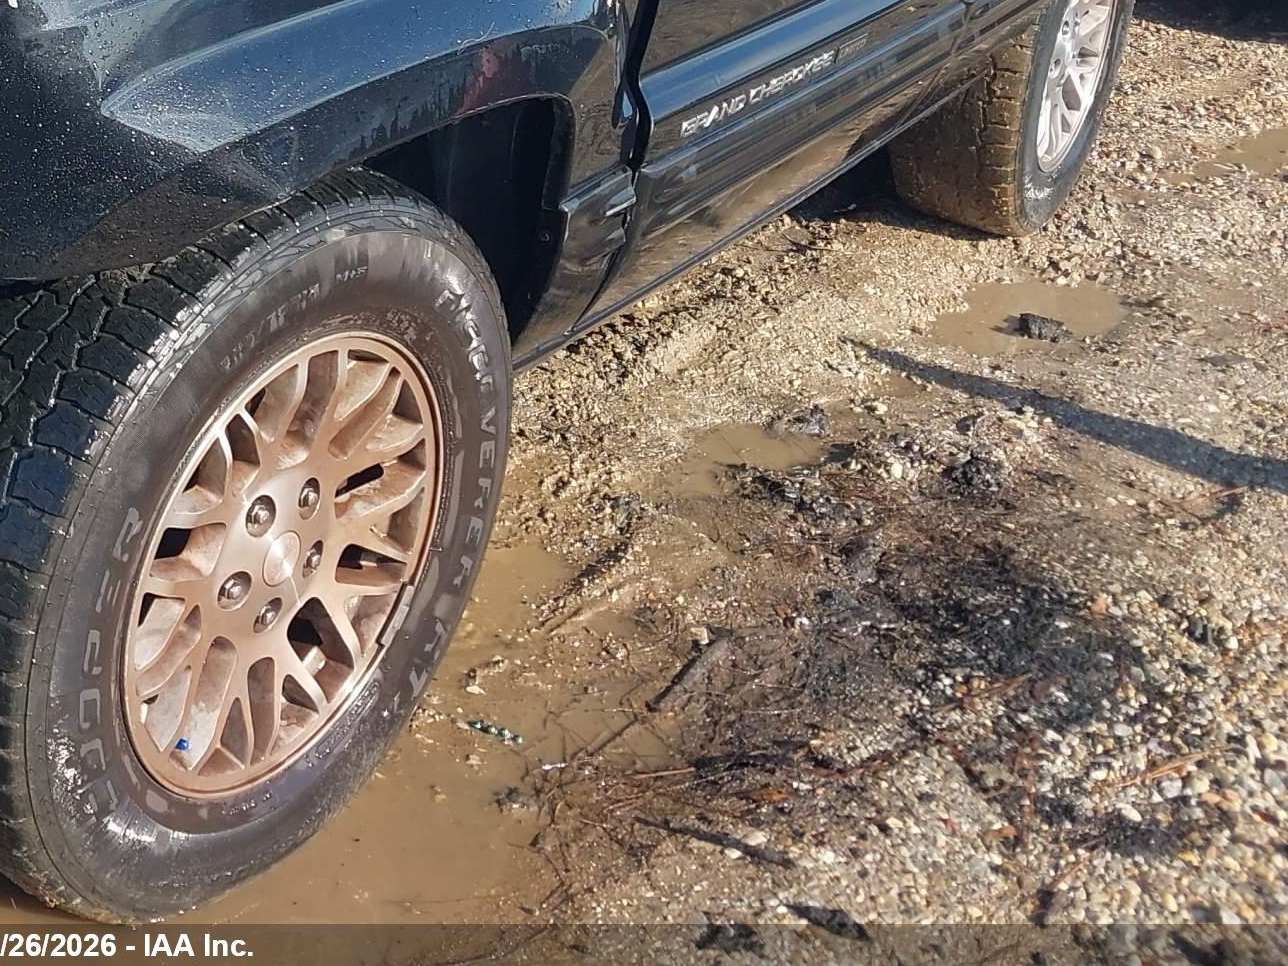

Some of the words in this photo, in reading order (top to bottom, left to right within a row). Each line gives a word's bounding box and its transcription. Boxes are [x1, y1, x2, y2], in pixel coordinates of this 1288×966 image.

[680, 94, 748, 138] GRAND
[748, 48, 835, 106] CHEROKEE
[79, 506, 143, 824] COOPER
